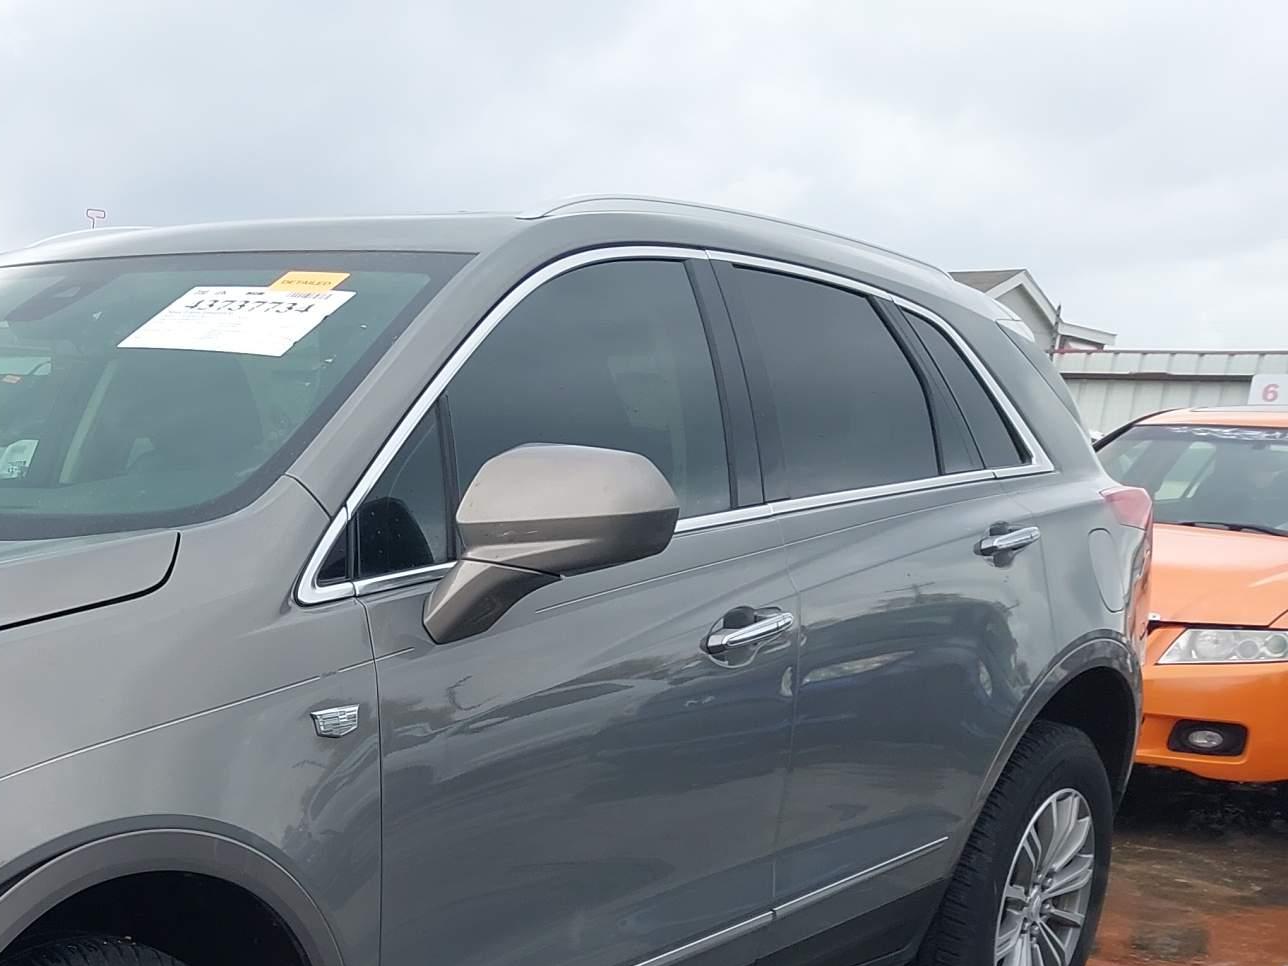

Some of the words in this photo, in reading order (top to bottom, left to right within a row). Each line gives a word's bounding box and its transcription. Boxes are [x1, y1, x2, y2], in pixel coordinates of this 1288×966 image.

[281, 278, 333, 287] DETAILED
[185, 299, 315, 314] 43737734
[1263, 384, 1281, 402] 6
